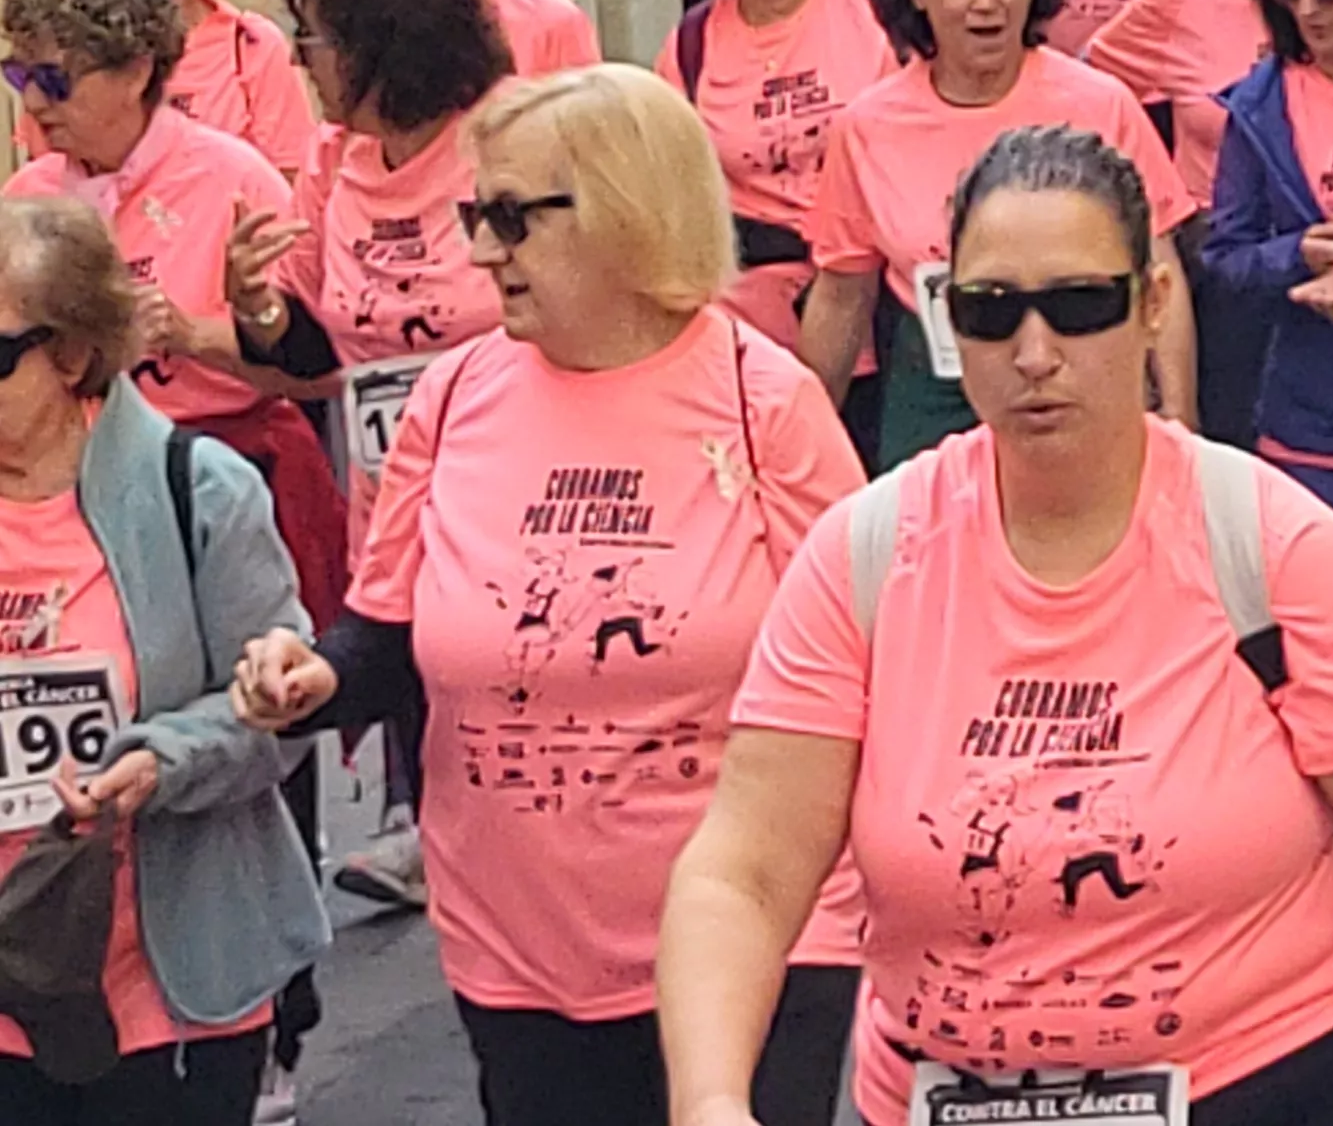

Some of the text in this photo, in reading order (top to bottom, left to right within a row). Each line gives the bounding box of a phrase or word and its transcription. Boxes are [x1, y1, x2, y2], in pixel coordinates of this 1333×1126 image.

[365, 409, 407, 453] 1
[545, 468, 643, 500] CORRAMOS
[520, 504, 556, 536] POR
[557, 502, 578, 534] LA
[995, 680, 1119, 719] CORRAMOS
[960, 717, 1008, 756] POR
[1009, 721, 1037, 758] LA
[941, 1098, 1031, 1123] CONTRA
[1036, 1095, 1060, 1118] EL
